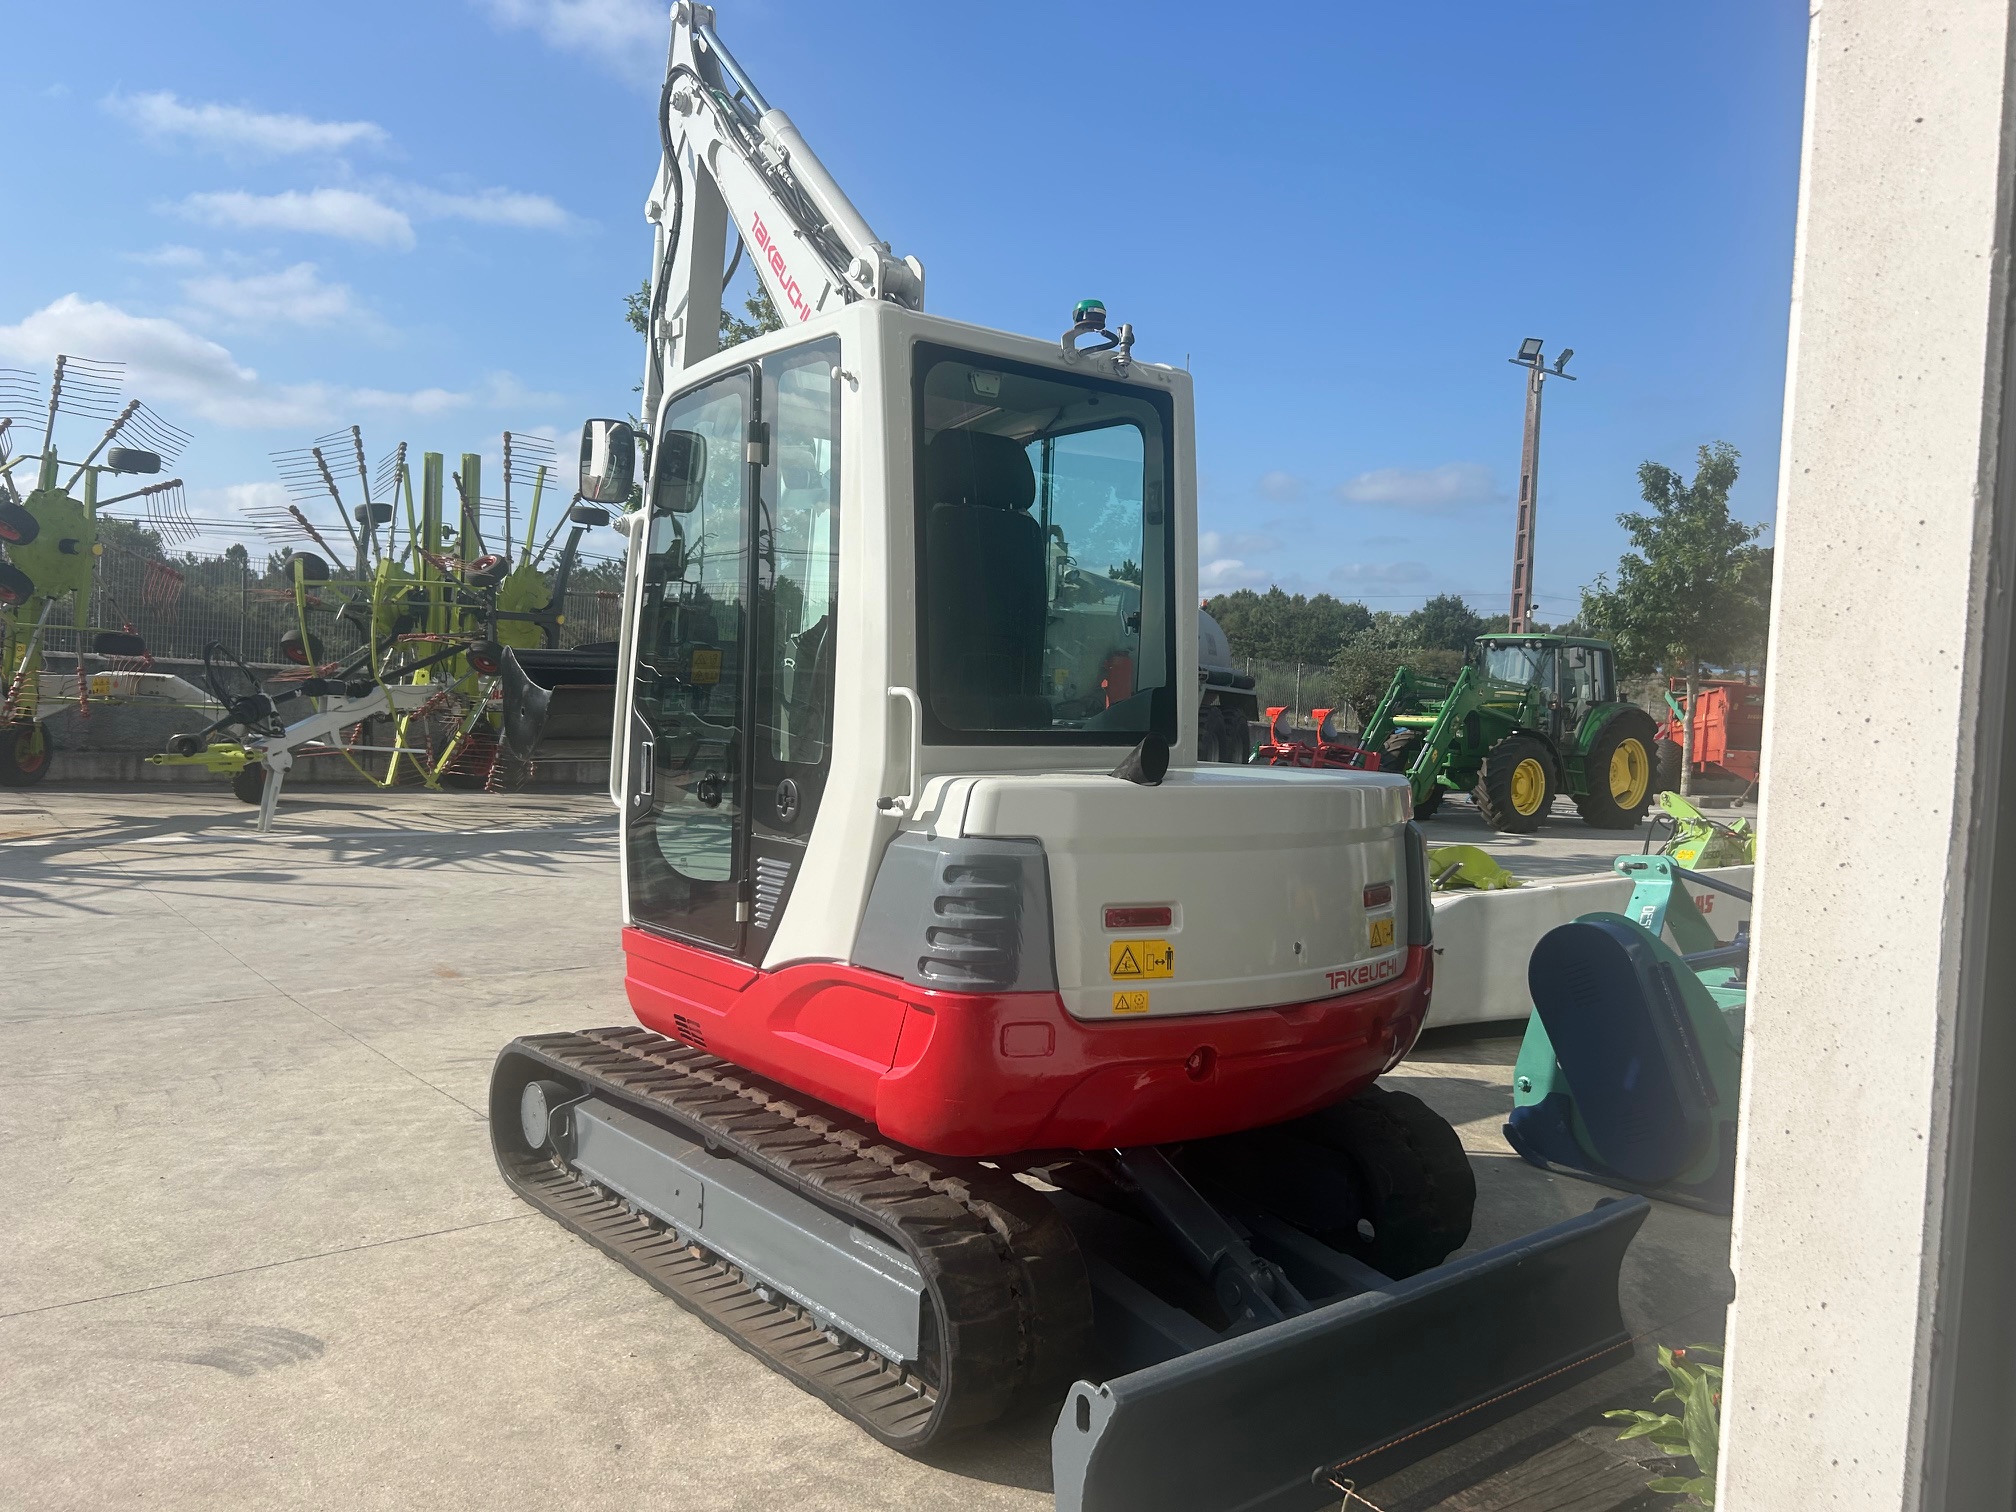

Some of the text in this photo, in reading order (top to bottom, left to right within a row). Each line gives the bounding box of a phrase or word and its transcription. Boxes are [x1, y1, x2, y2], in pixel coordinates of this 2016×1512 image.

[751, 210, 811, 322] TAKEUCHI
[1638, 905, 1656, 929] DES
[1692, 894, 1715, 914] AS
[1325, 958, 1397, 990] TAKEUCHI
